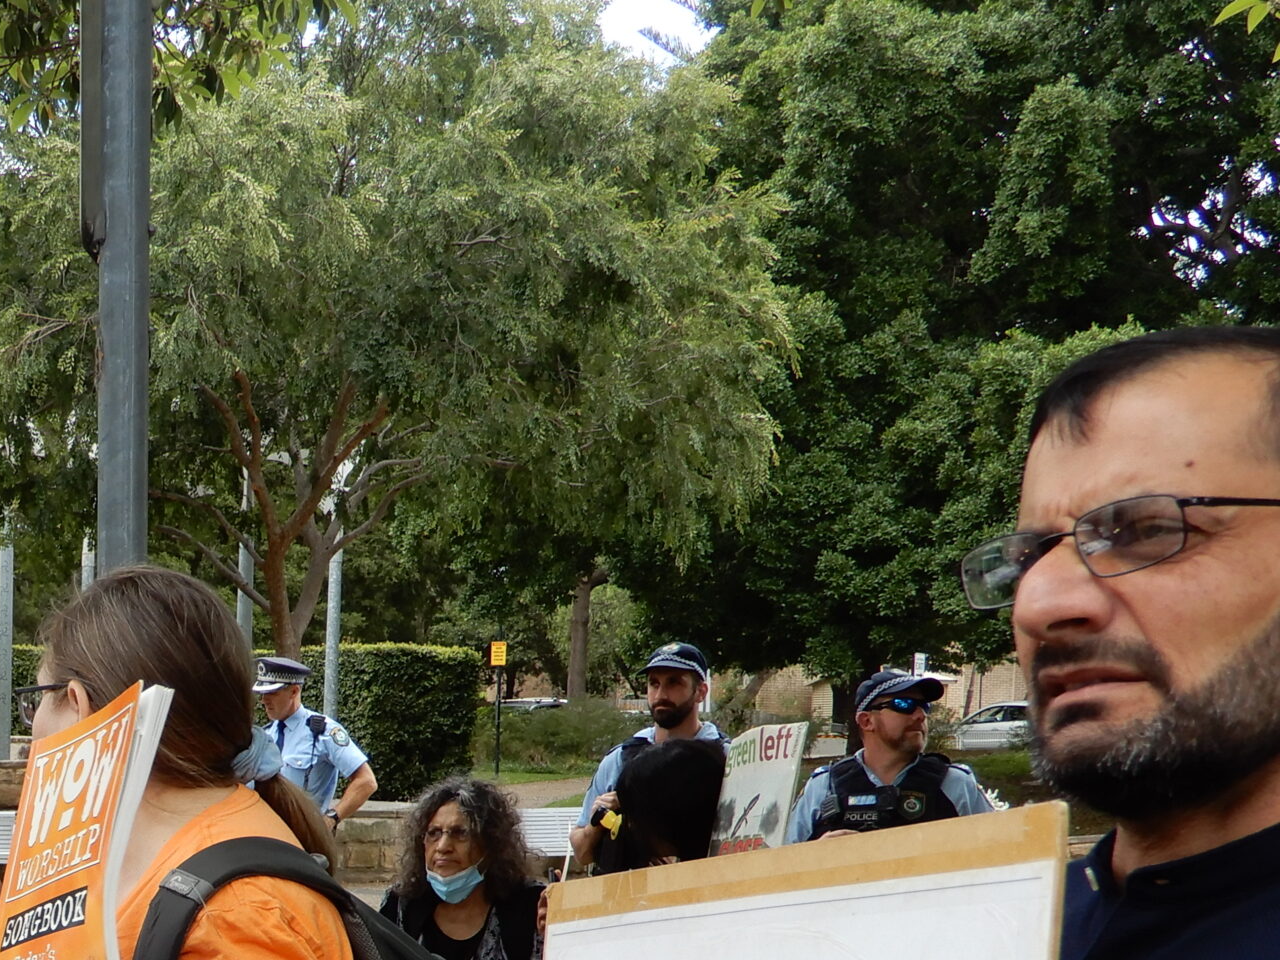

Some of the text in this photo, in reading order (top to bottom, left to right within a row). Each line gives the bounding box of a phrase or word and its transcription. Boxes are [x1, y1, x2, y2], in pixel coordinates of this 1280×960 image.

[724, 737, 756, 778] green
[759, 725, 793, 762] left
[28, 716, 129, 848] WOW
[844, 812, 878, 821] POLICE
[16, 823, 101, 891] WORSHIP
[2, 891, 87, 948] SONGBOOK
